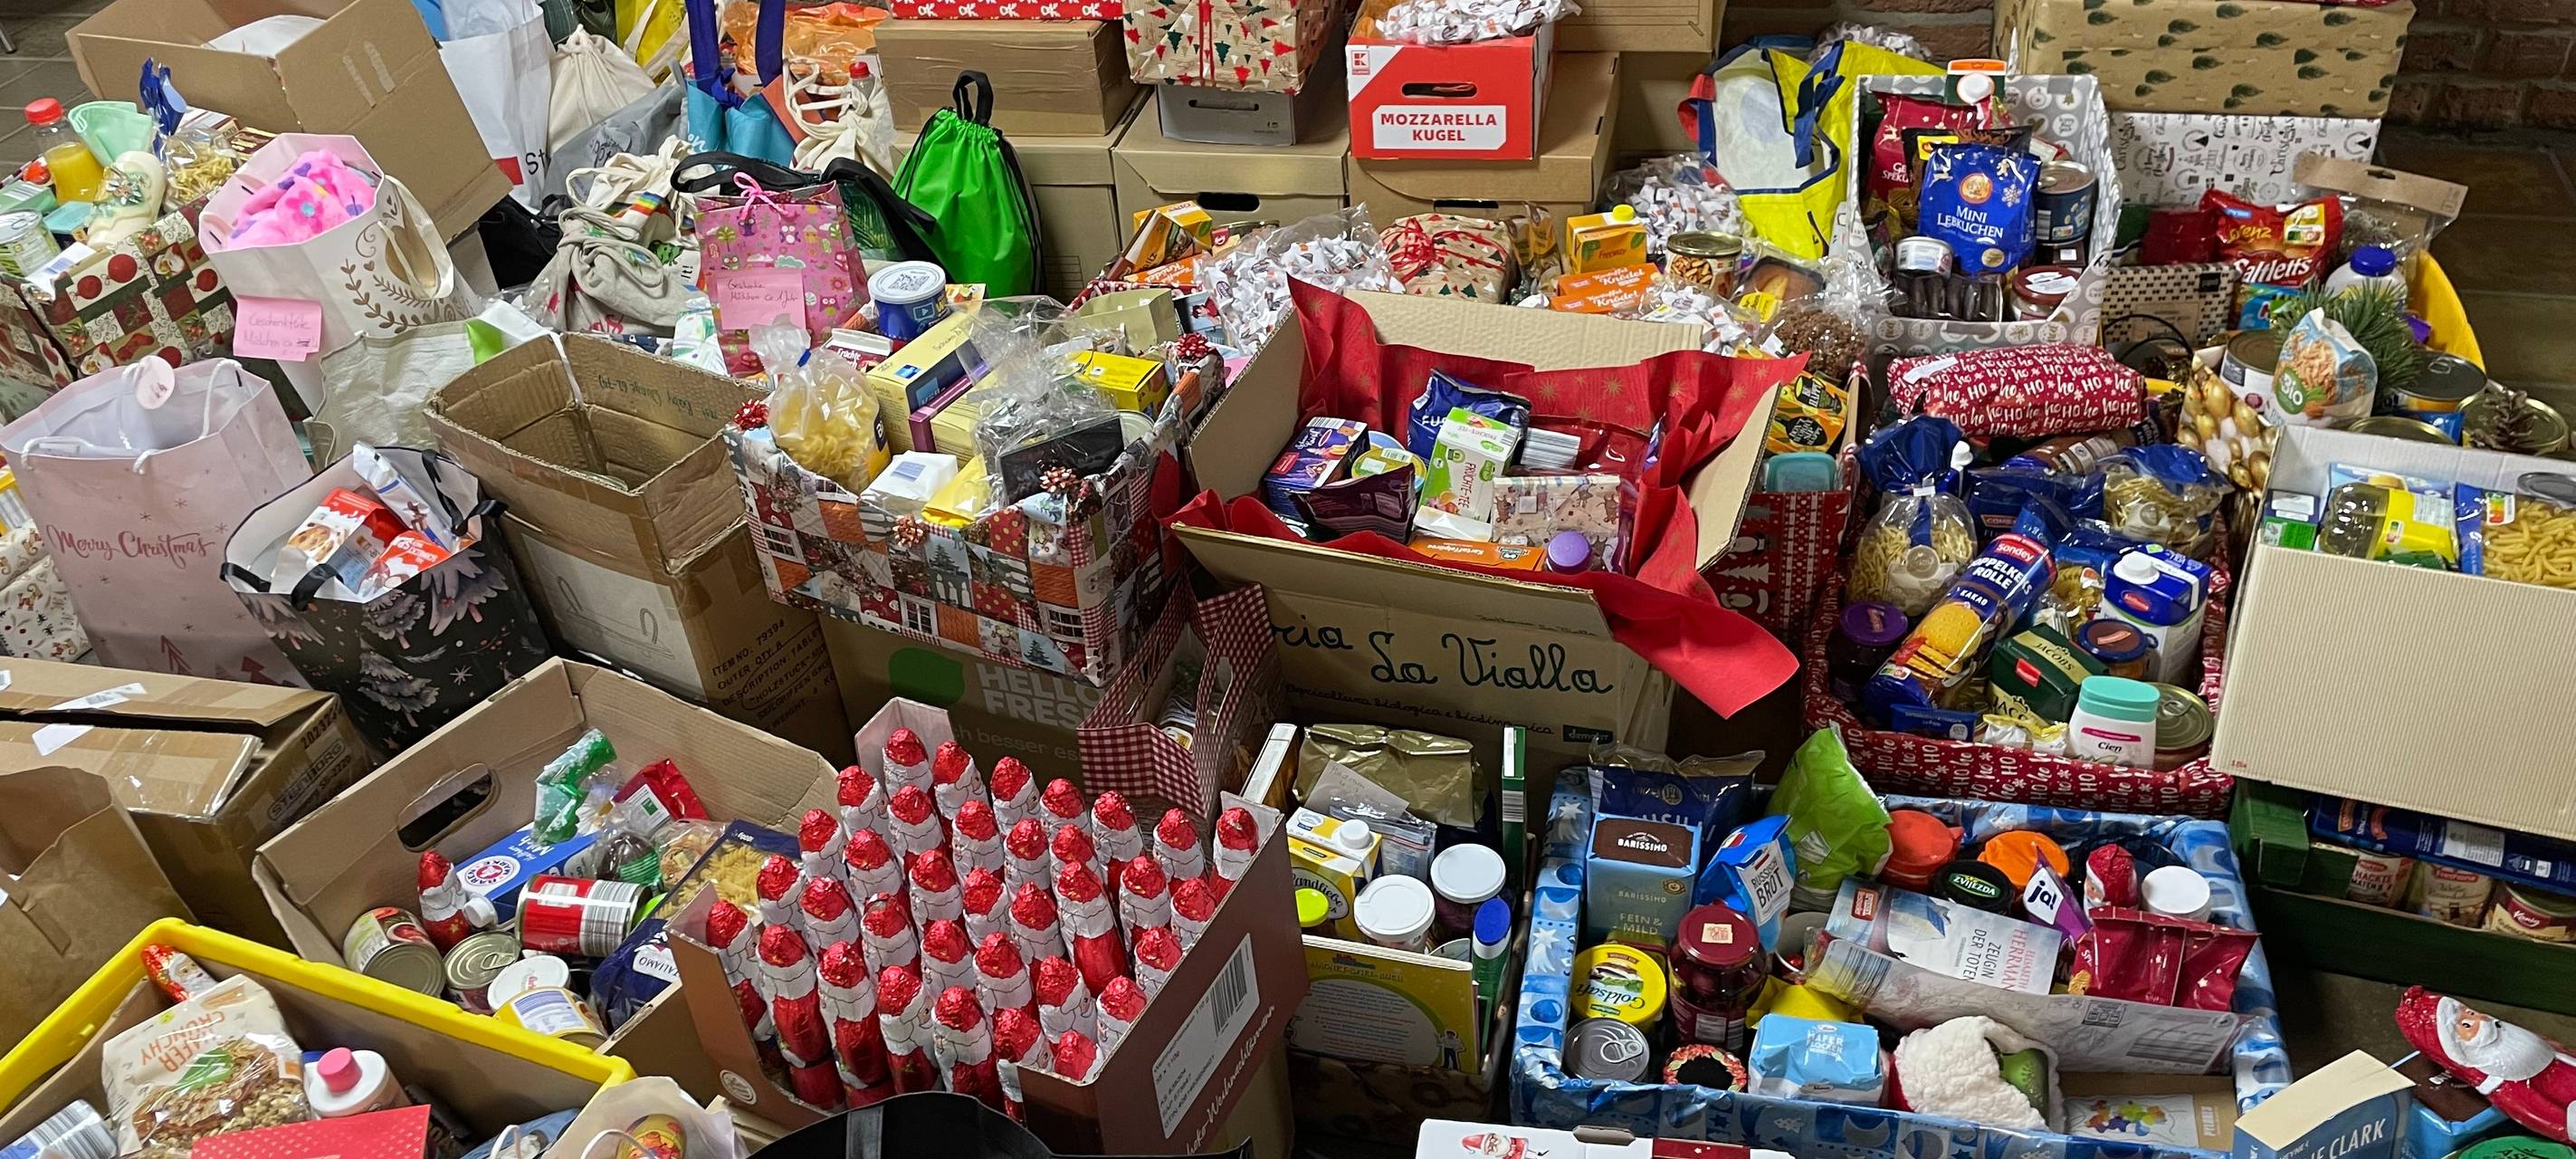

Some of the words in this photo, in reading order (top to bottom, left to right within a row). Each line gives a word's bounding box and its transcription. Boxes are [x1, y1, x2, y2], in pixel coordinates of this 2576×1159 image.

[1380, 113, 1497, 126] MOZZARELLA
[1412, 129, 1465, 141] KUGEL
[1937, 213, 2004, 239] LEBKUCHEN
[1956, 205, 1988, 224] MINI
[1968, 382, 1988, 398] HO
[2024, 378, 2044, 395] HO
[2082, 377, 2102, 392] HO
[1457, 462, 1476, 509] FRÜCHTE-TEE
[46, 523, 120, 561] Merry
[118, 530, 216, 570] Christmas
[1996, 542, 2035, 563] Sondey
[1972, 566, 2014, 590] ROLLE
[1959, 589, 1989, 608] KAKAO
[711, 657, 736, 676] ITEM
[1441, 632, 1615, 694] Vialla
[2033, 642, 2075, 671] JACOBS
[717, 665, 751, 690] OUTER
[976, 663, 1104, 708] HELLO
[983, 688, 1088, 730] FRES
[977, 726, 1047, 754] besser
[2097, 741, 2123, 753] Cien
[1617, 838, 1668, 853] BARISSIMO
[1618, 891, 1666, 904] BARISSIMO
[1756, 867, 1784, 909] BROT
[1952, 875, 1997, 897] ZVIJEZDA
[2027, 879, 2058, 911] ja!
[1620, 913, 1651, 924] FEIN
[1623, 923, 1659, 936] MILD
[1970, 928, 1988, 948] DER
[637, 956, 680, 979] TALIAMO
[1980, 941, 2002, 979] ZEUGIN
[1575, 983, 1646, 1011] Goldsaft
[140, 1010, 225, 1066] CRUNCHY
[2329, 1118, 2388, 1159] CLARK
